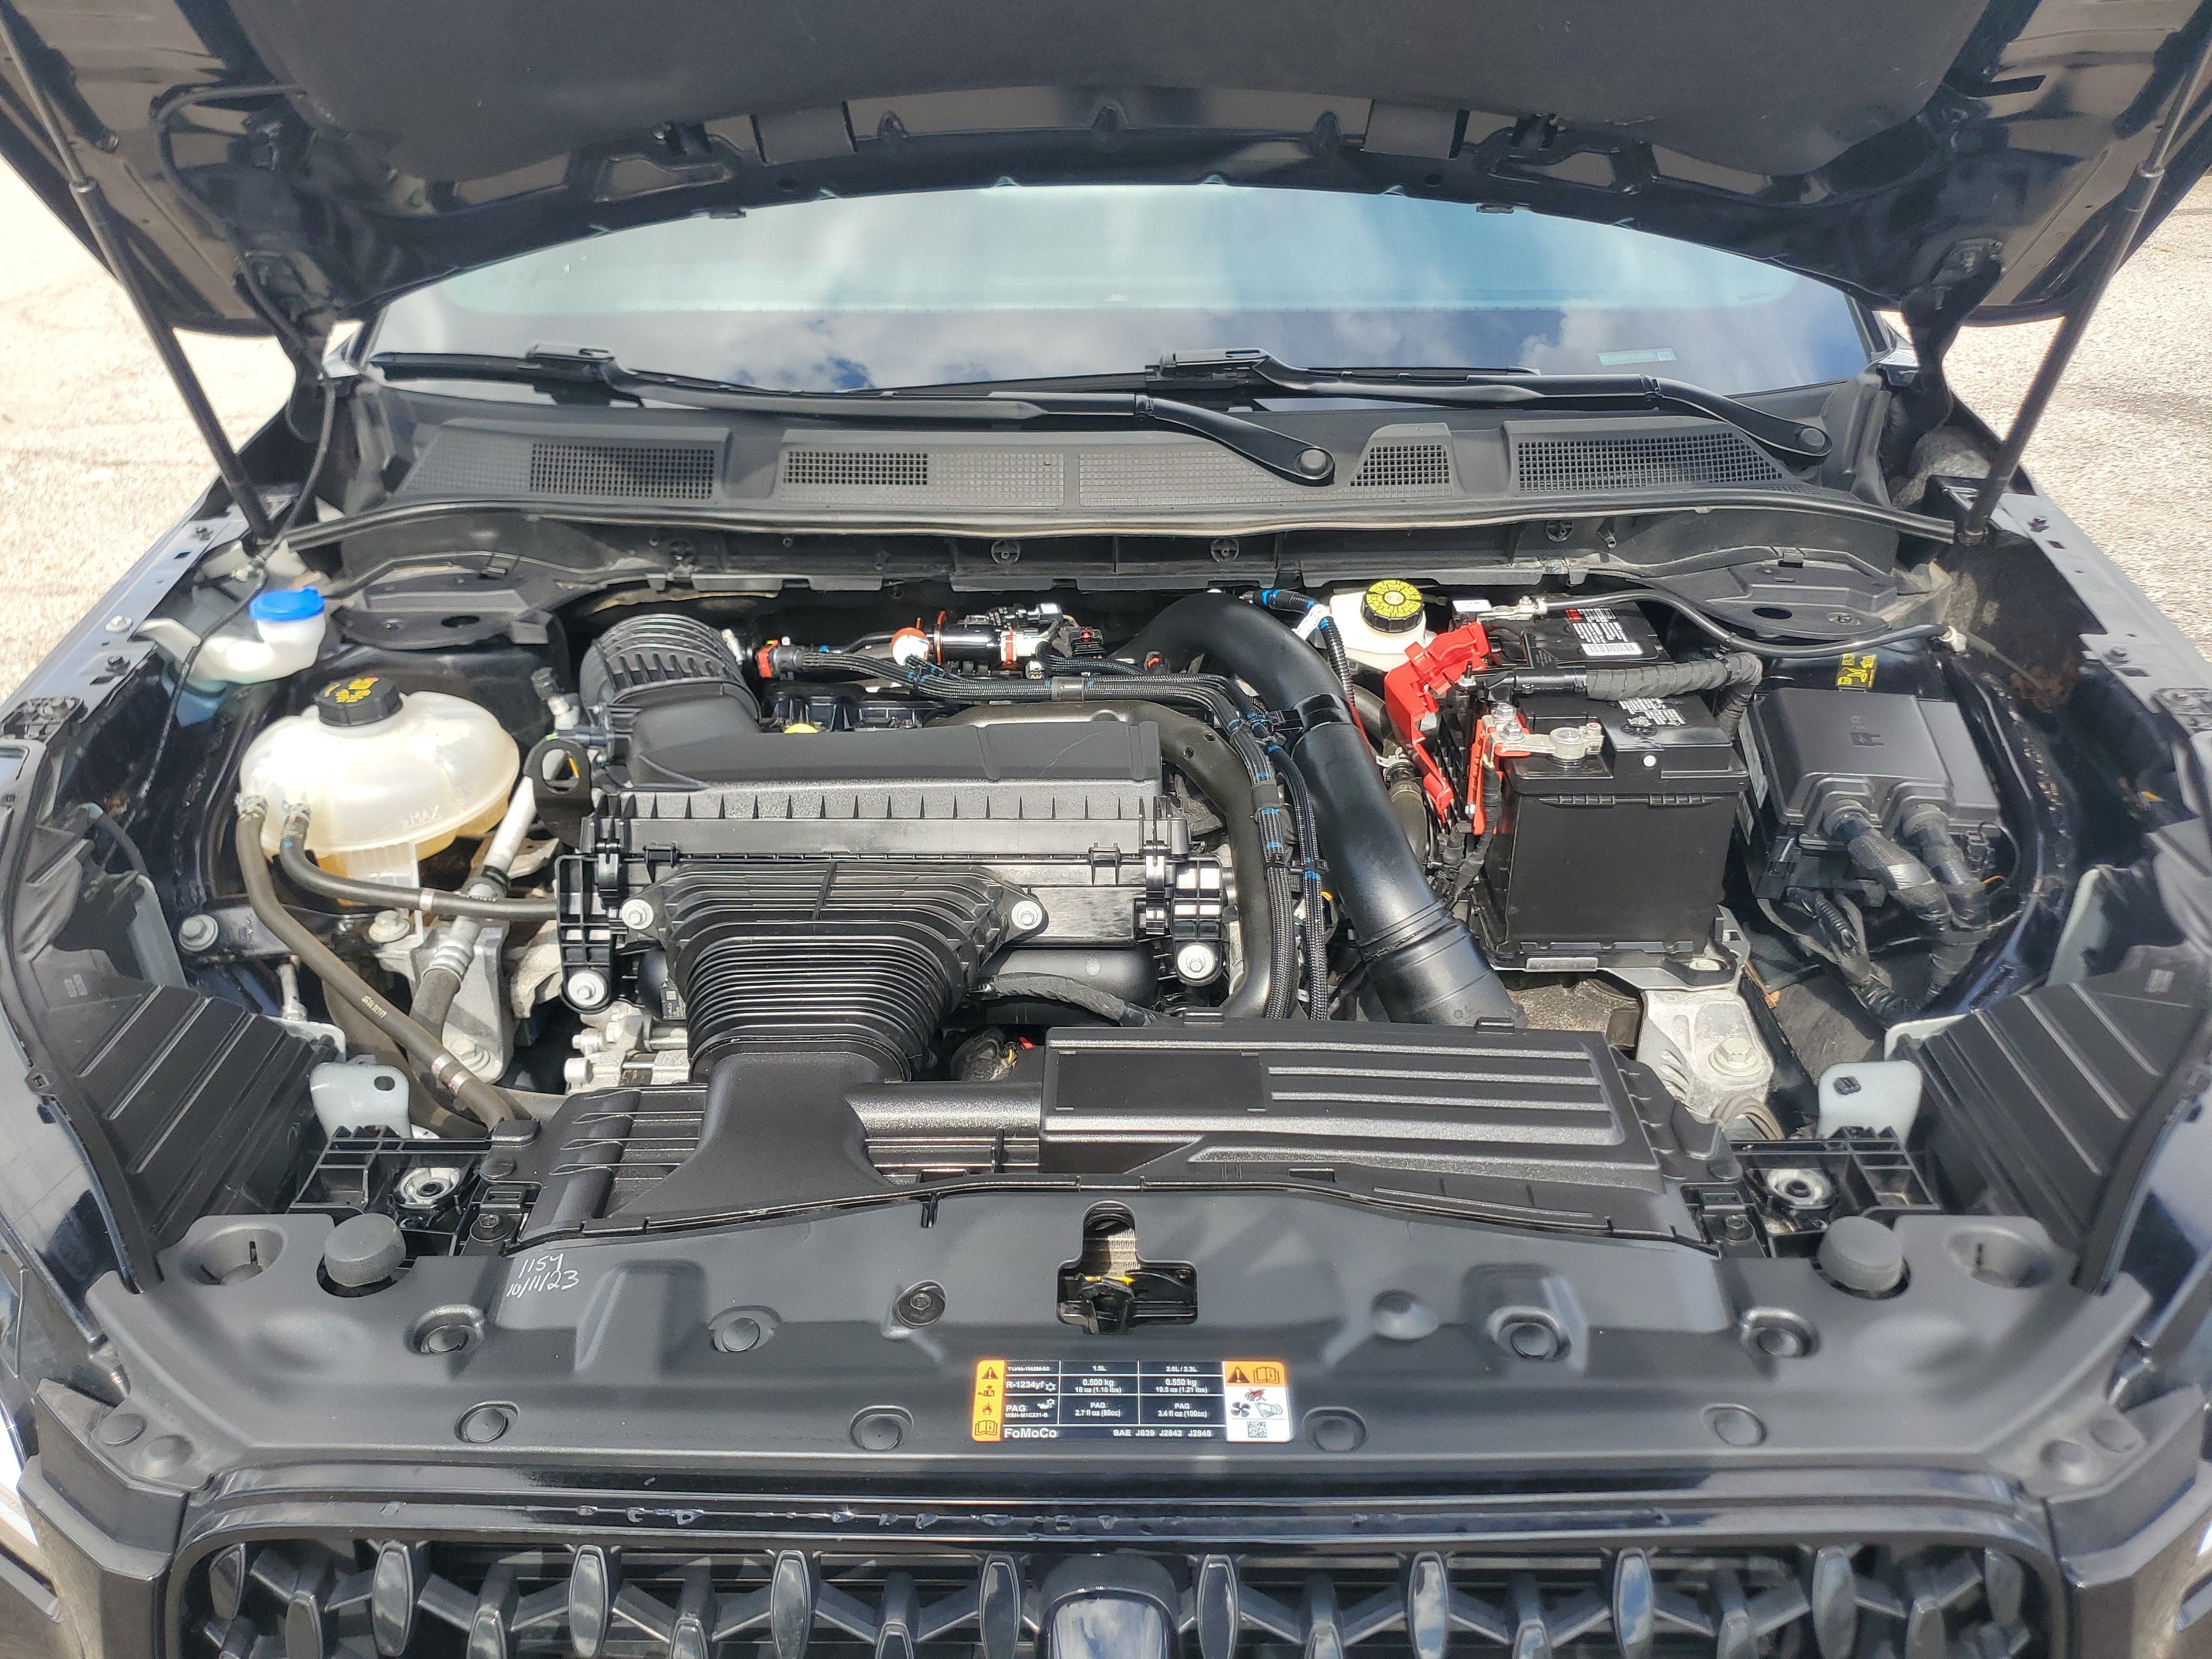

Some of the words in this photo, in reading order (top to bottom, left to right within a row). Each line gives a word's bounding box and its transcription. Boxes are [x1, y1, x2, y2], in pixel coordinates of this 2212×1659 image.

[1006, 1380, 1045, 1390] R-1234yf
[1104, 1378, 1114, 1387] kg
[1187, 1378, 1197, 1387] kg
[1184, 1410, 1207, 1418] (100cc)
[1004, 1427, 1057, 1438] FoMoCo
